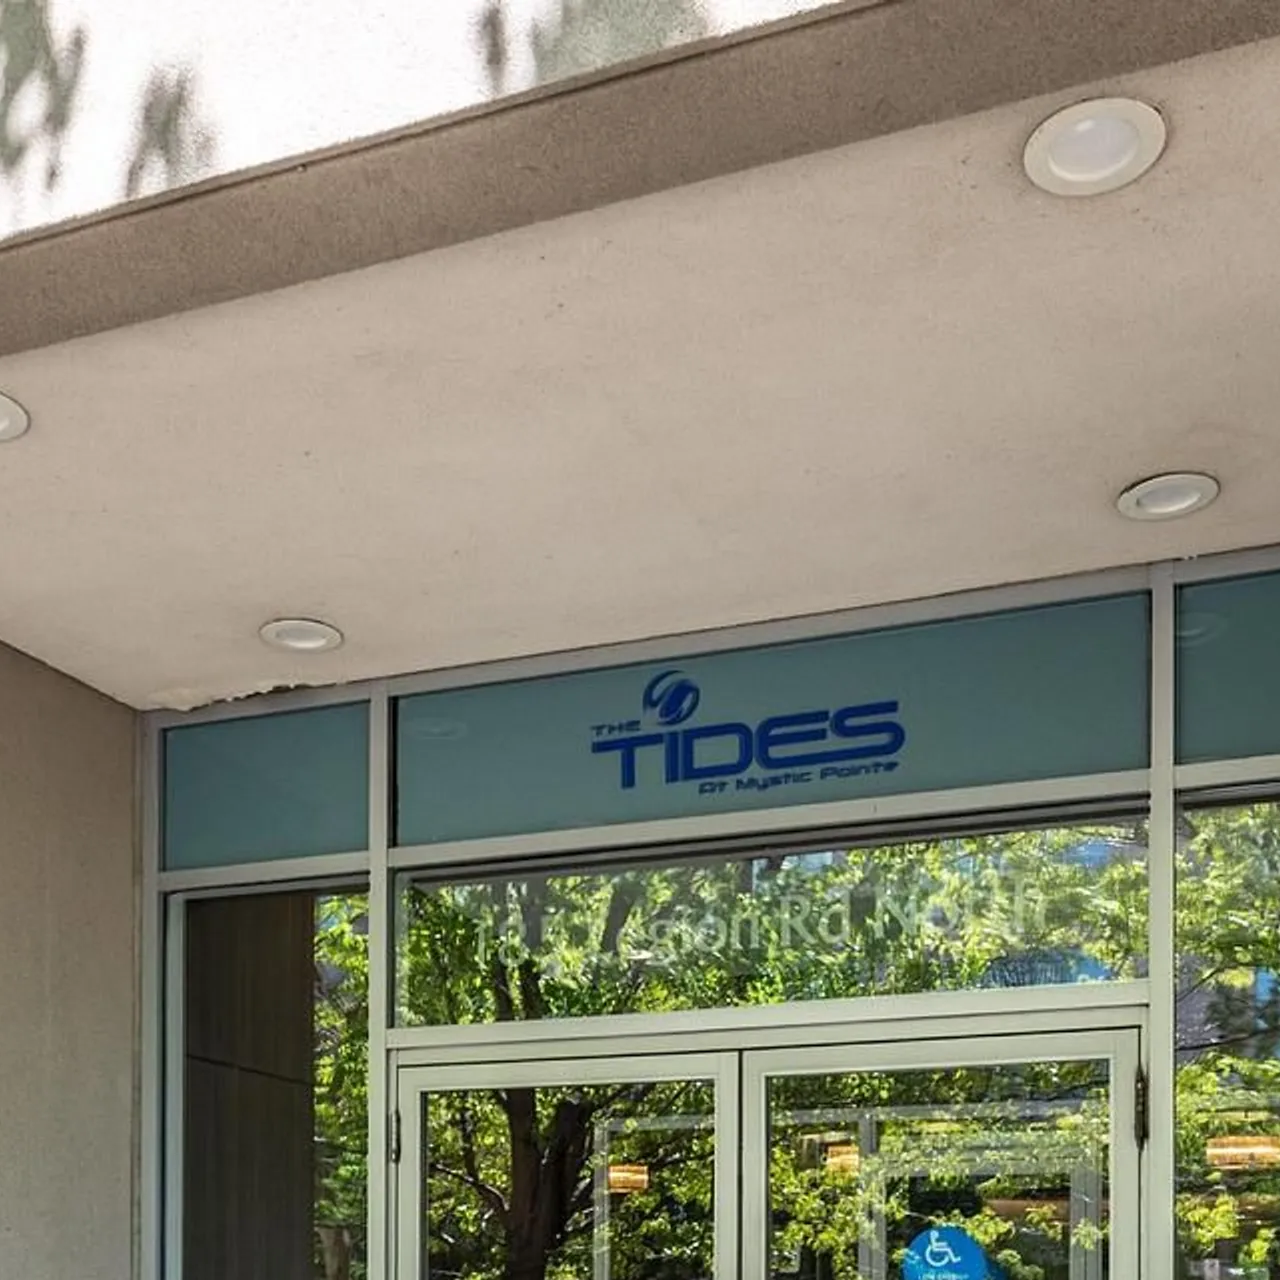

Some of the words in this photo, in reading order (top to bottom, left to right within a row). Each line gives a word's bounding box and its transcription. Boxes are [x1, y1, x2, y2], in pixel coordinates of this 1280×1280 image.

[590, 719, 641, 736] THE
[591, 699, 905, 789] TIDES
[780, 884, 852, 948] Rd
